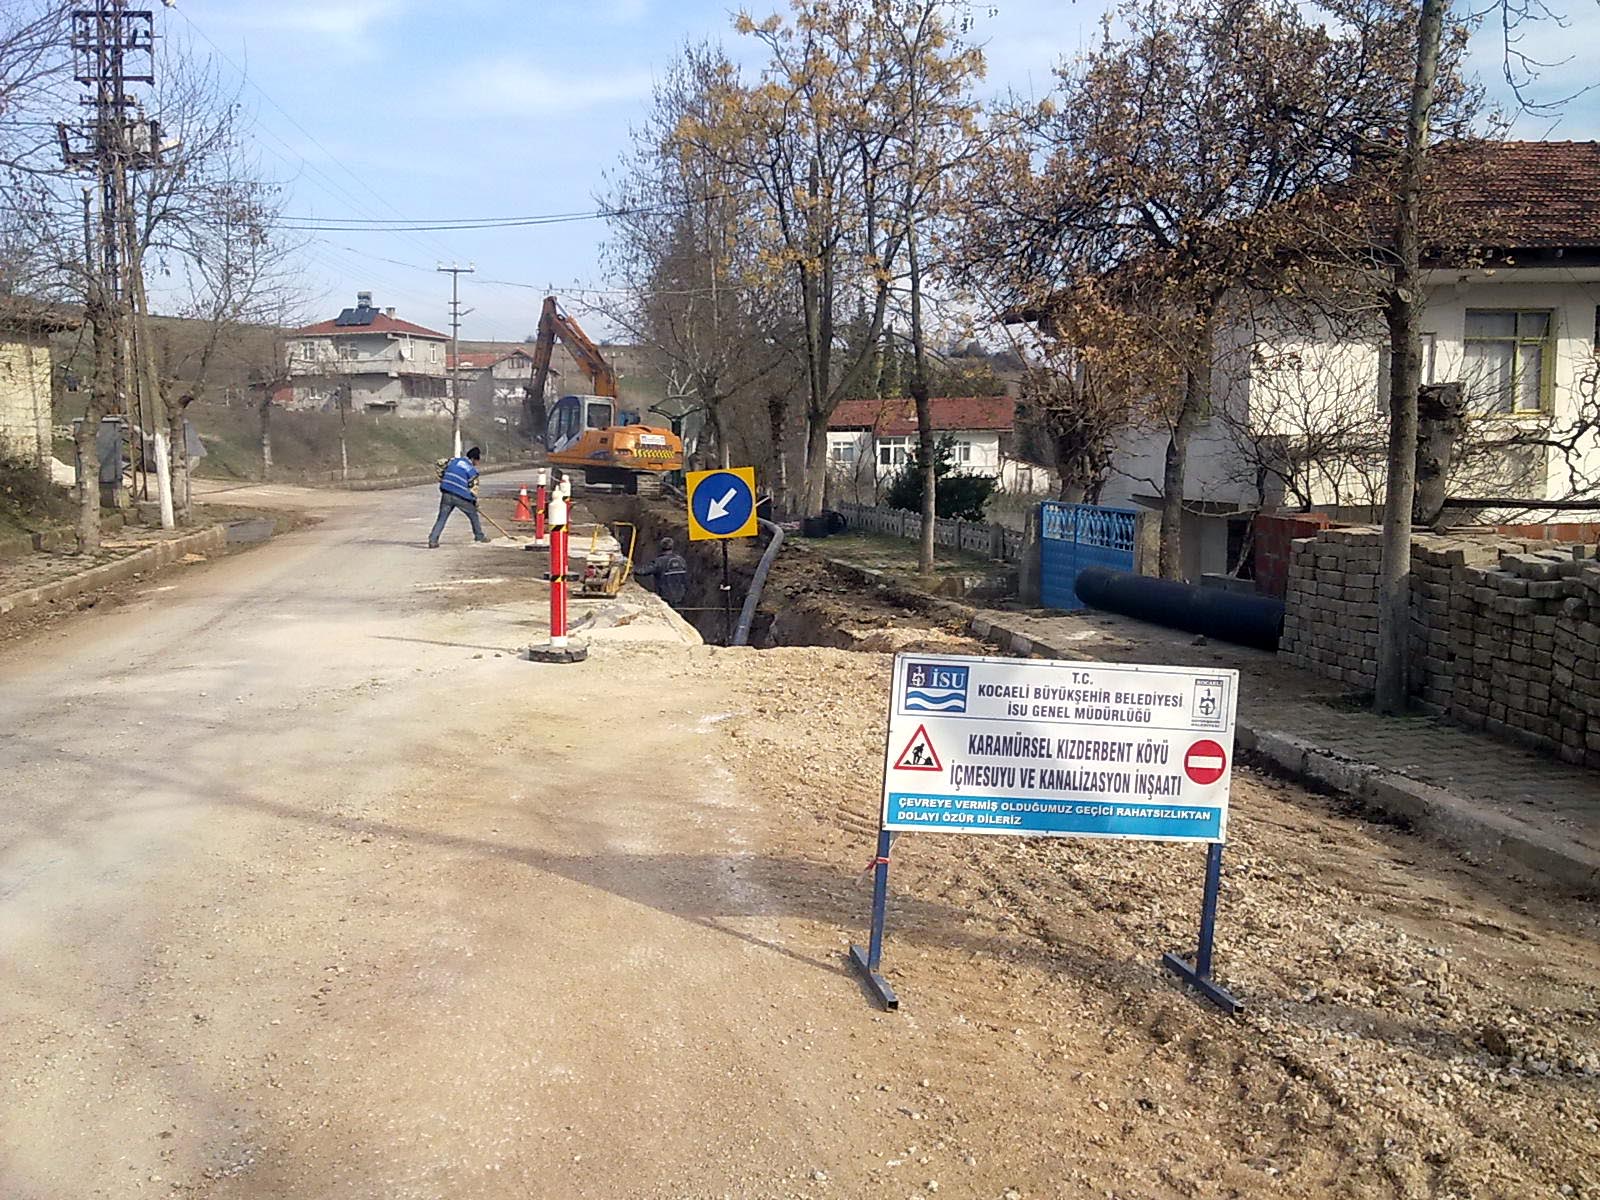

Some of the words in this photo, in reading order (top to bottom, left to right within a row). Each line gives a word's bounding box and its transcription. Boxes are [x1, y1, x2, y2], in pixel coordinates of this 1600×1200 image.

[932, 668, 965, 688] İSU
[1072, 672, 1094, 685] T.C.
[978, 684, 1030, 699] KOCAELİ
[1033, 685, 1111, 705] BÜYÜKŞEHİR
[1114, 692, 1183, 707] BELEDİYESİ
[1007, 703, 1028, 716] İSU
[1032, 705, 1071, 718] GENEL
[1075, 704, 1152, 723] MÜDÜRLÜĞÜ
[968, 731, 1053, 759] KARAMÜRSEL
[1056, 739, 1134, 763] KIZDERBENT
[1136, 738, 1169, 765] KÖYÜ
[950, 759, 1016, 791] İÇMESUYU
[1020, 768, 1035, 788] VE
[1039, 767, 1131, 793] KANALİZASYON
[1134, 769, 1182, 799] İNŞAATI
[897, 811, 940, 822] DOLAYI
[943, 812, 975, 824] ÖZÜR
[977, 814, 1022, 825] DİLERİZ
[898, 797, 953, 810] ÇEVREYE
[955, 799, 998, 812] VERMİŞ
[1001, 801, 1073, 814] OLDUĞUMUZ
[1076, 806, 1114, 818] GEÇİCİ
[1116, 808, 1211, 820] RAHATSIZLIKTAN
